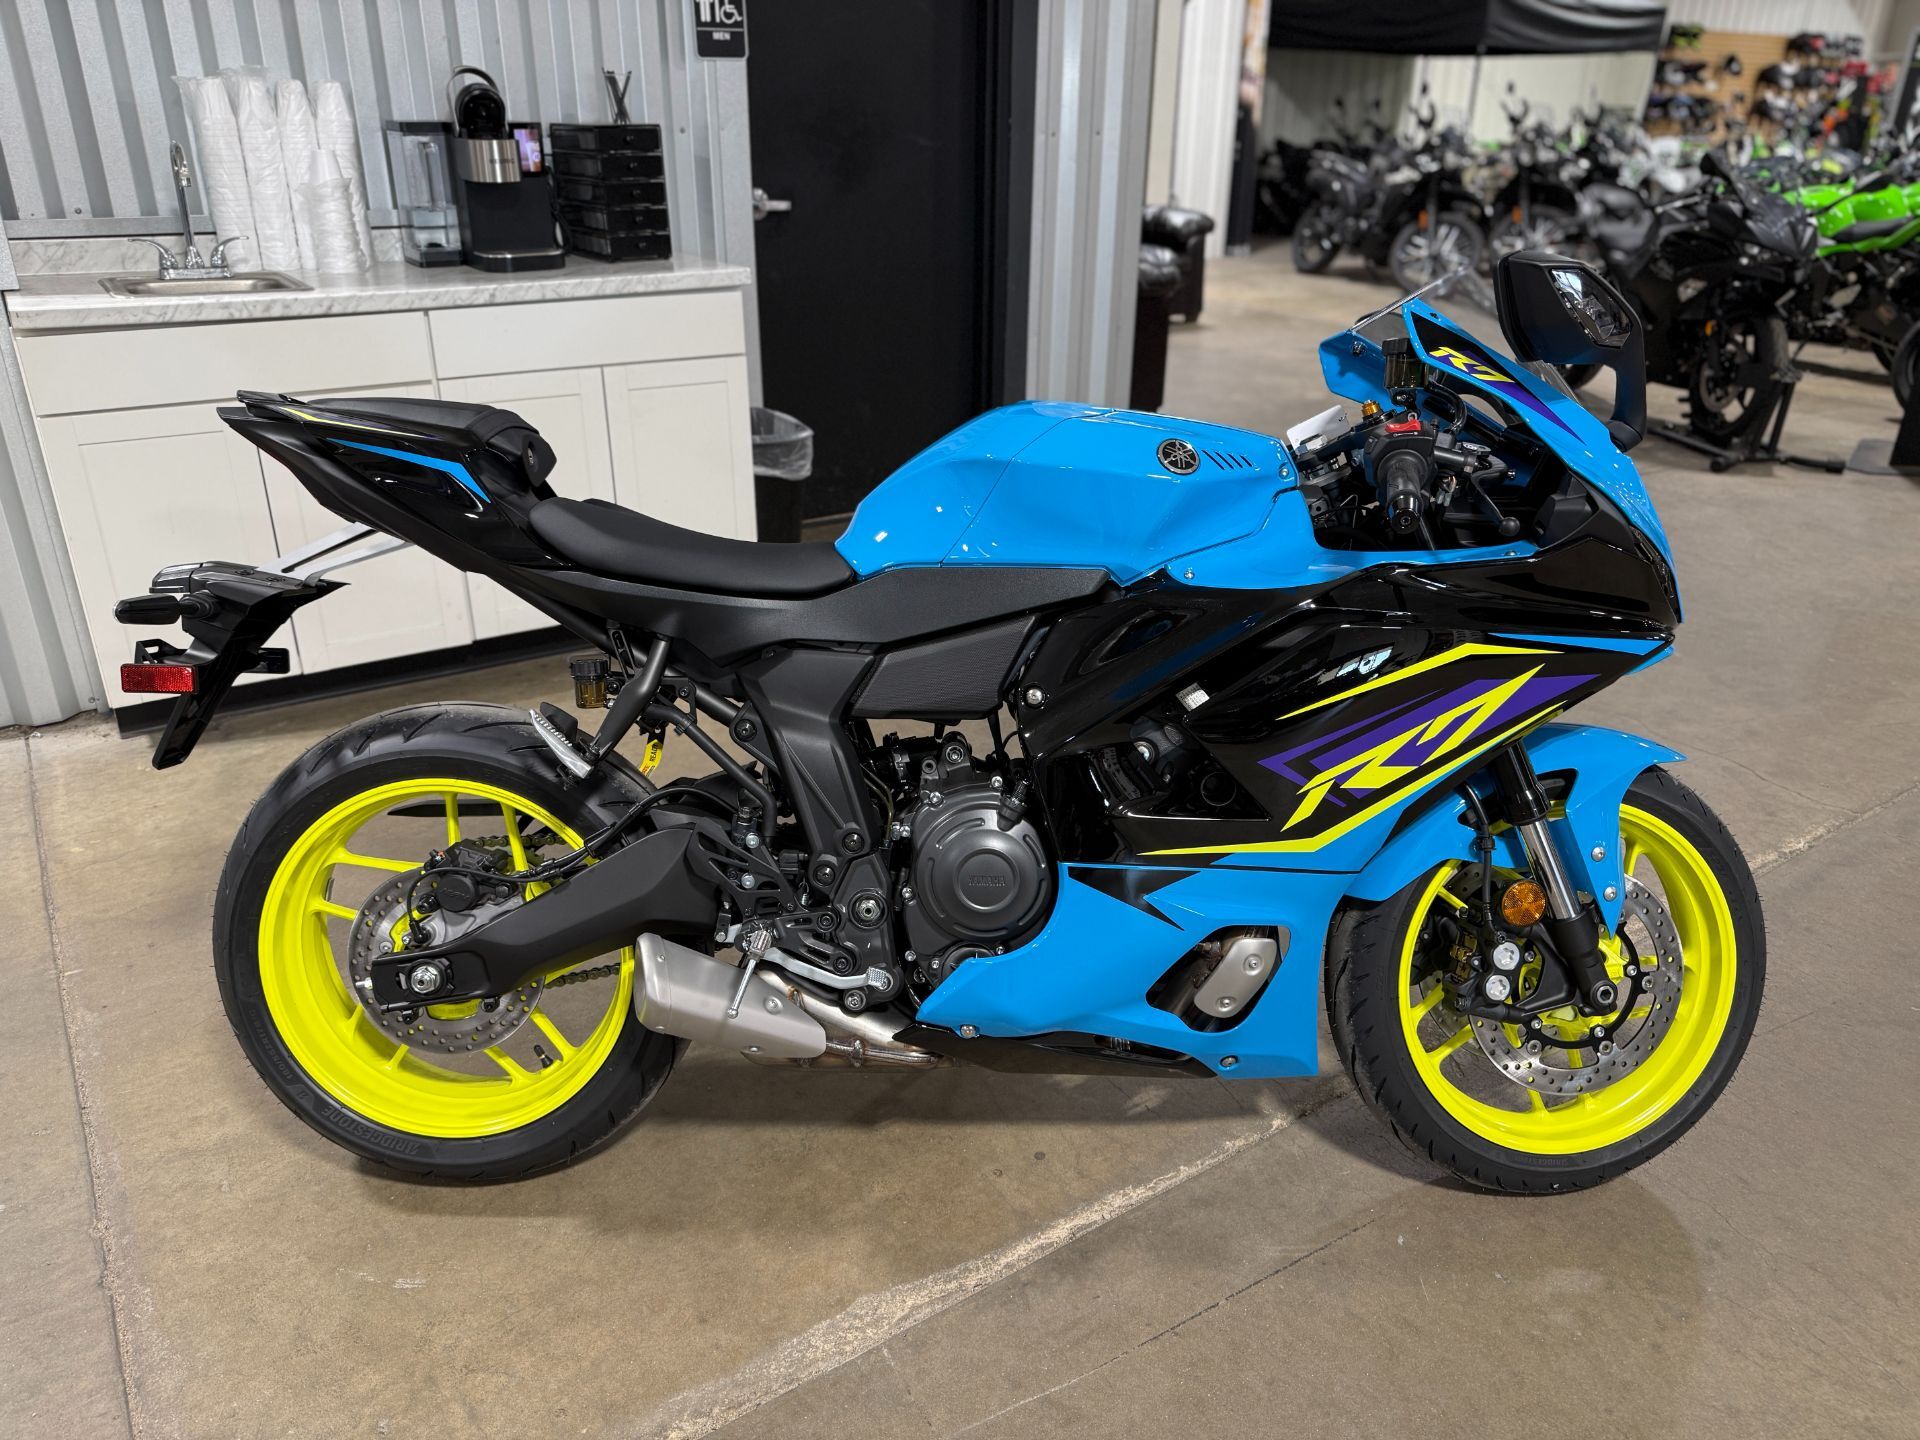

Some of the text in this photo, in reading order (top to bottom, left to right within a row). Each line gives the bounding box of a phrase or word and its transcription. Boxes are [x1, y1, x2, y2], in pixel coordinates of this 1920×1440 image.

[712, 31, 731, 41] MEN
[1429, 346, 1515, 383] R7
[1280, 663, 1546, 832] R7
